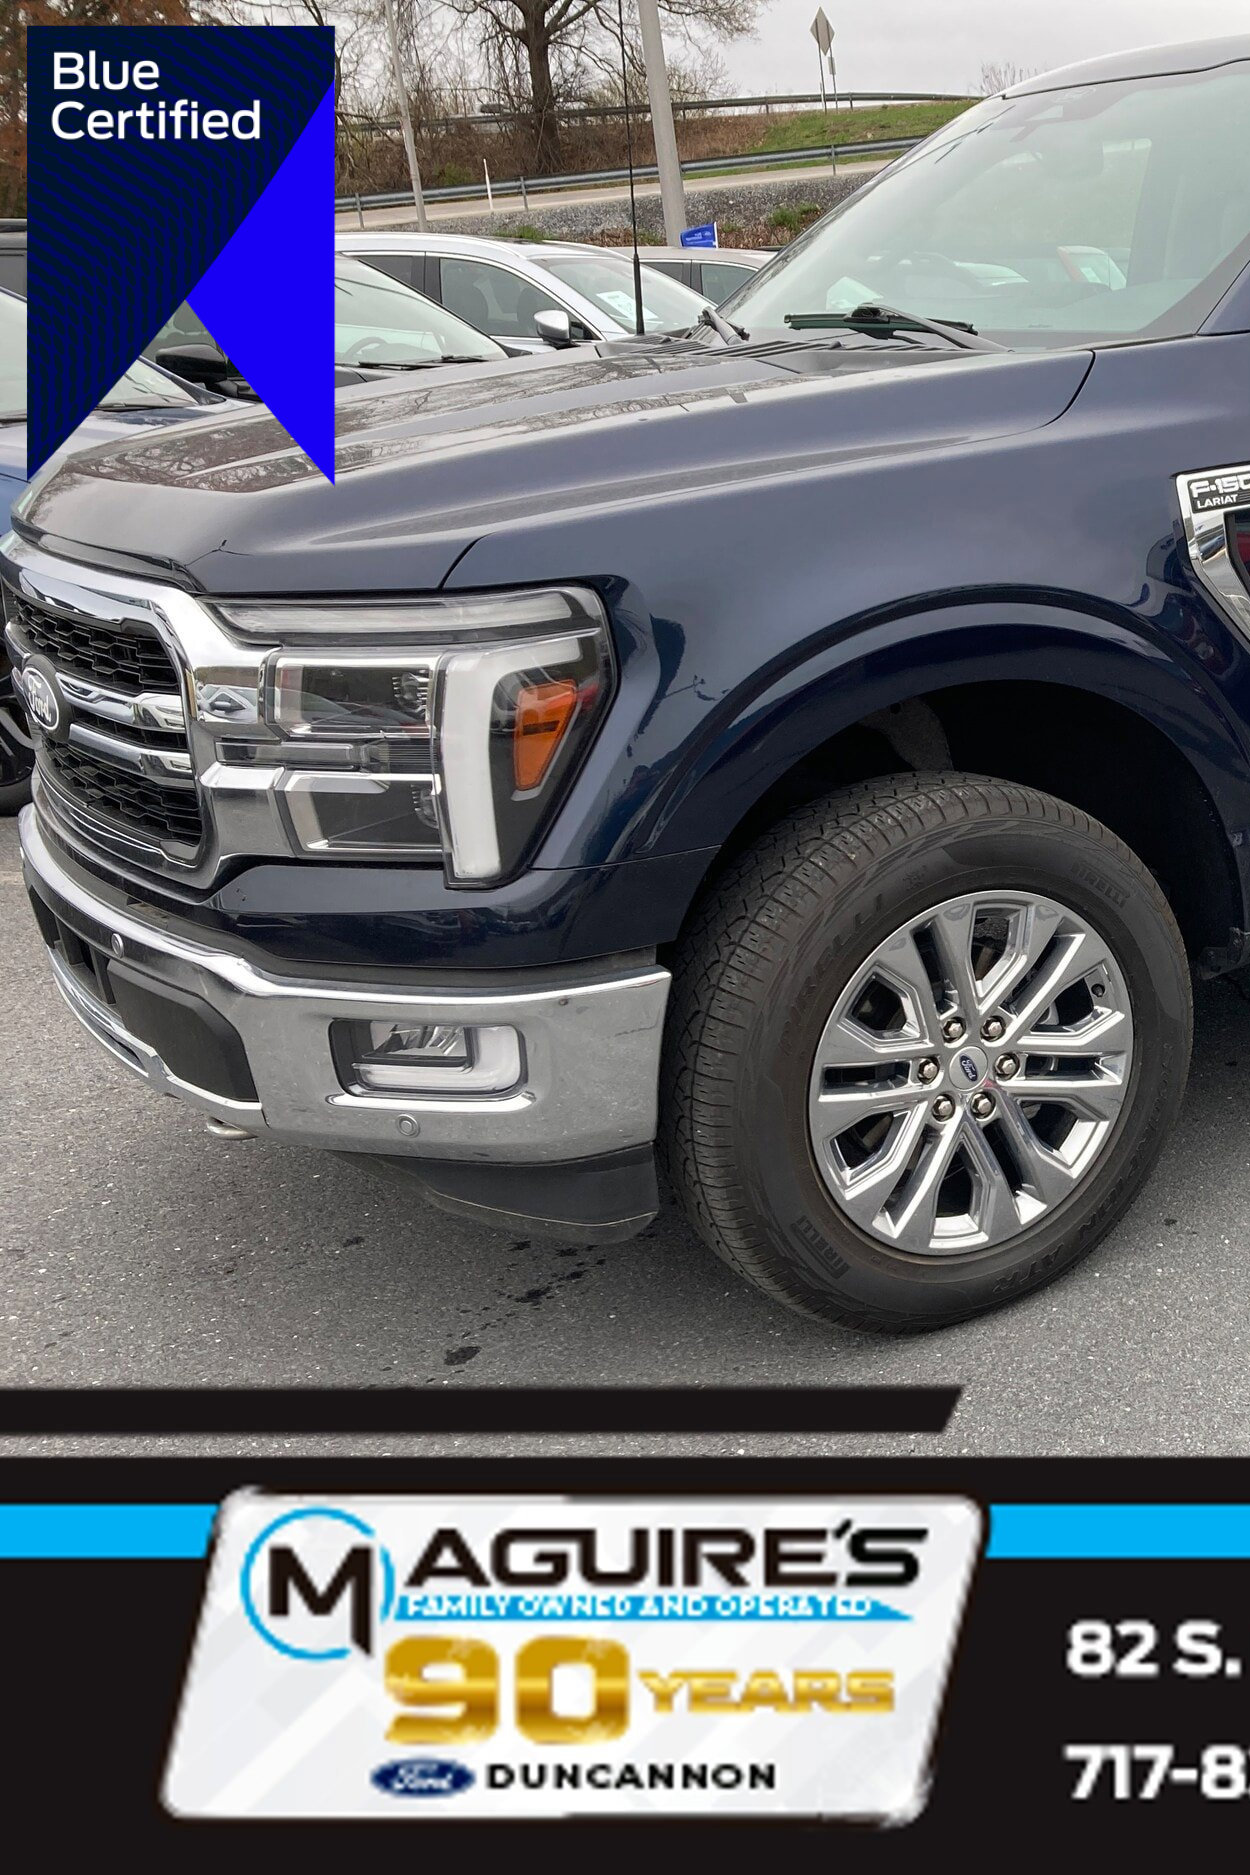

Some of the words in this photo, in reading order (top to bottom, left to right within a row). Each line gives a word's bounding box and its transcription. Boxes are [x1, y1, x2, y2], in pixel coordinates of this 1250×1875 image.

[1197, 494, 1238, 509] LARIAT
[27, 673, 53, 723] Ford
[961, 1058, 977, 1080] Ford
